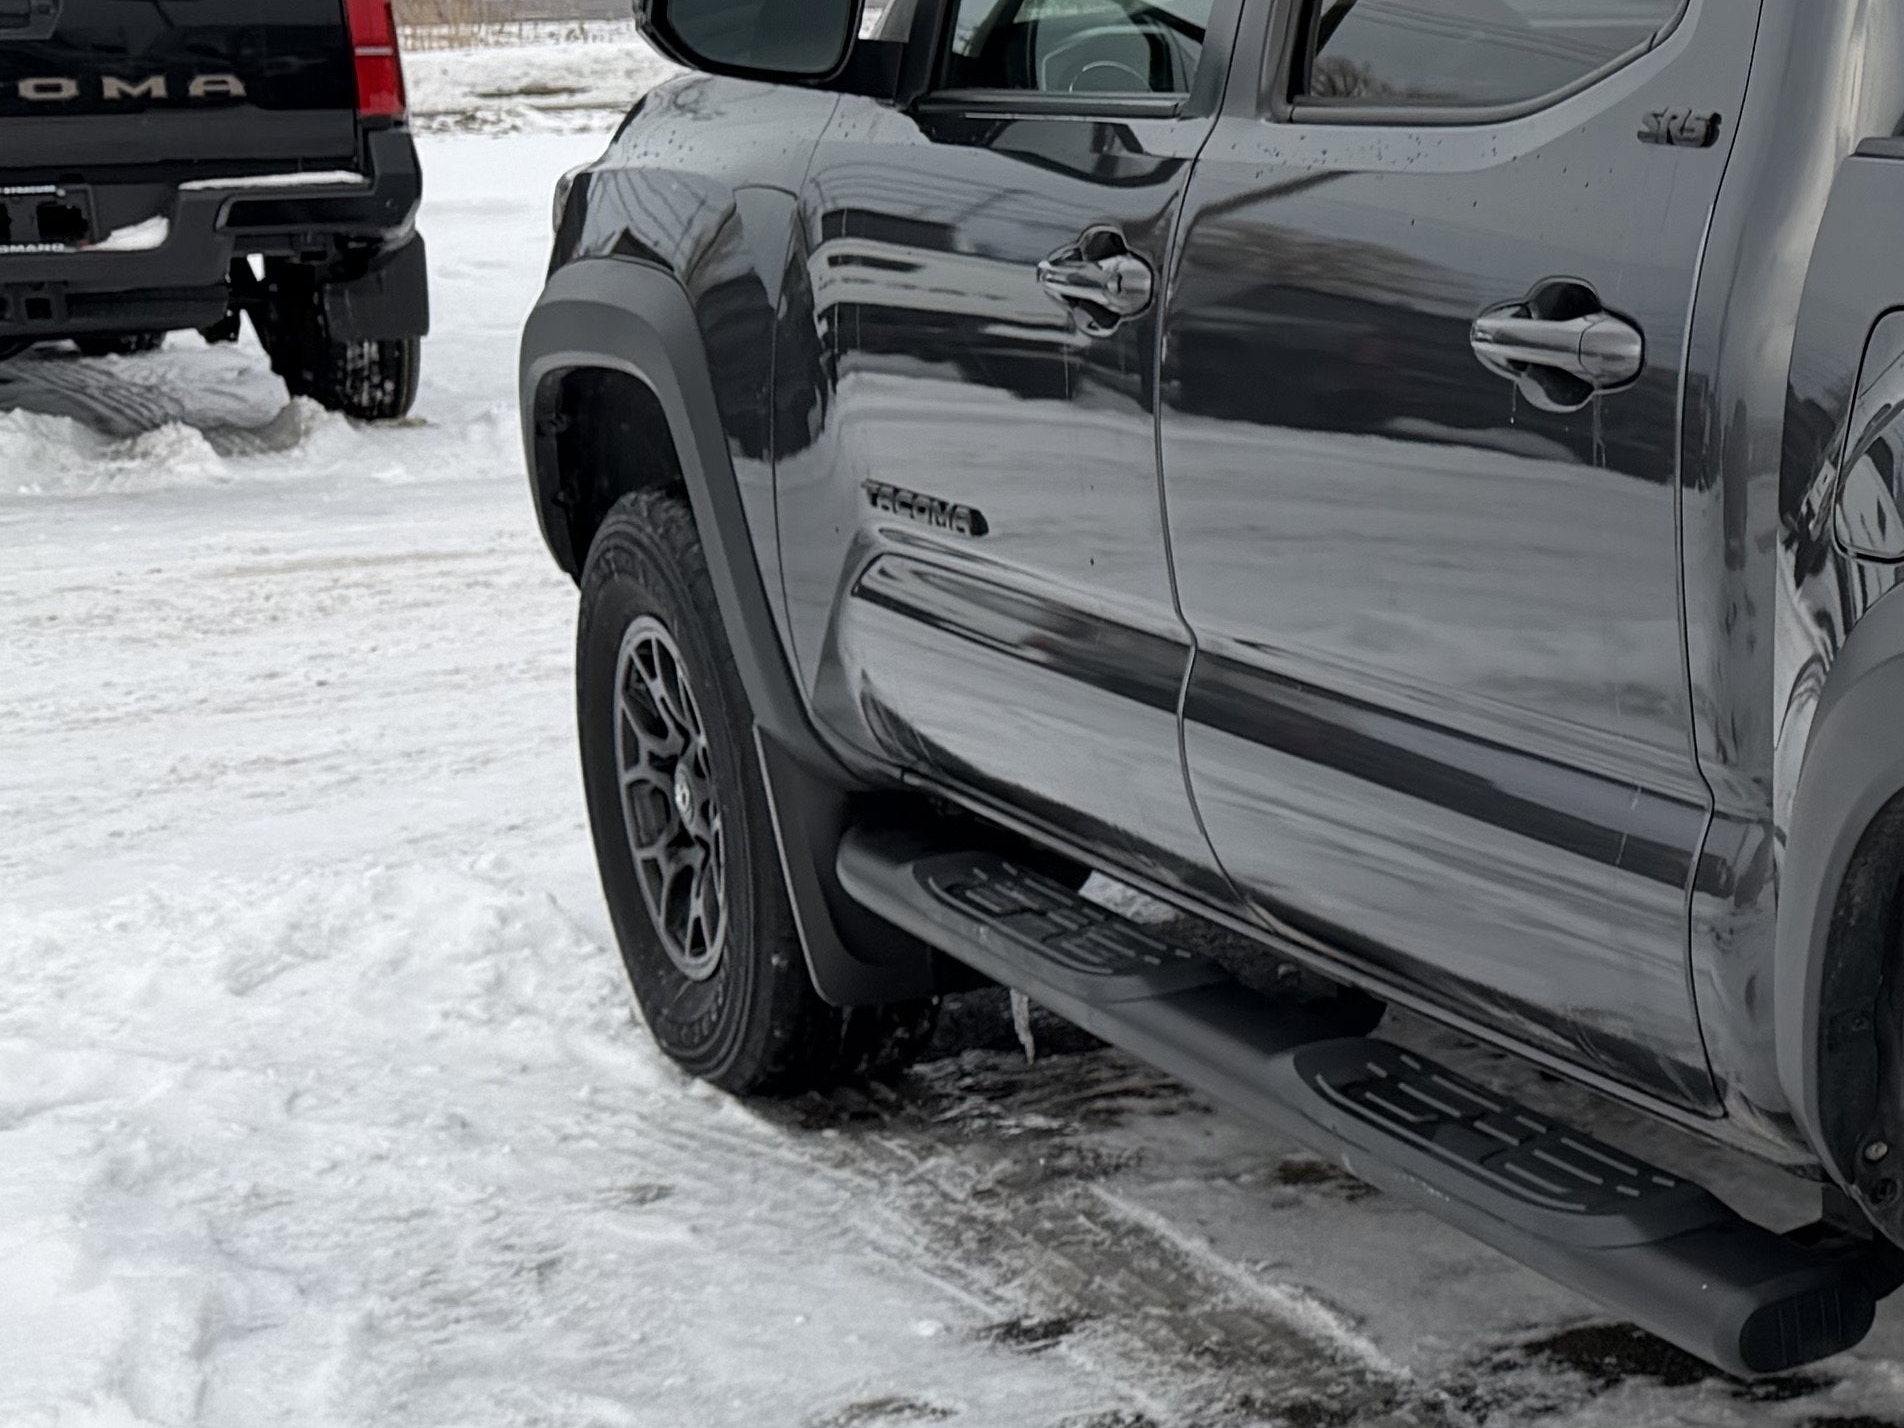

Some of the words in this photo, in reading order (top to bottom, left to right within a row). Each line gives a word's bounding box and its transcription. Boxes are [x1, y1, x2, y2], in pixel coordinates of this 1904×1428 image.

[17, 73, 247, 101] OMA
[1637, 106, 1722, 149] SR5
[859, 476, 990, 537] TACOMA
